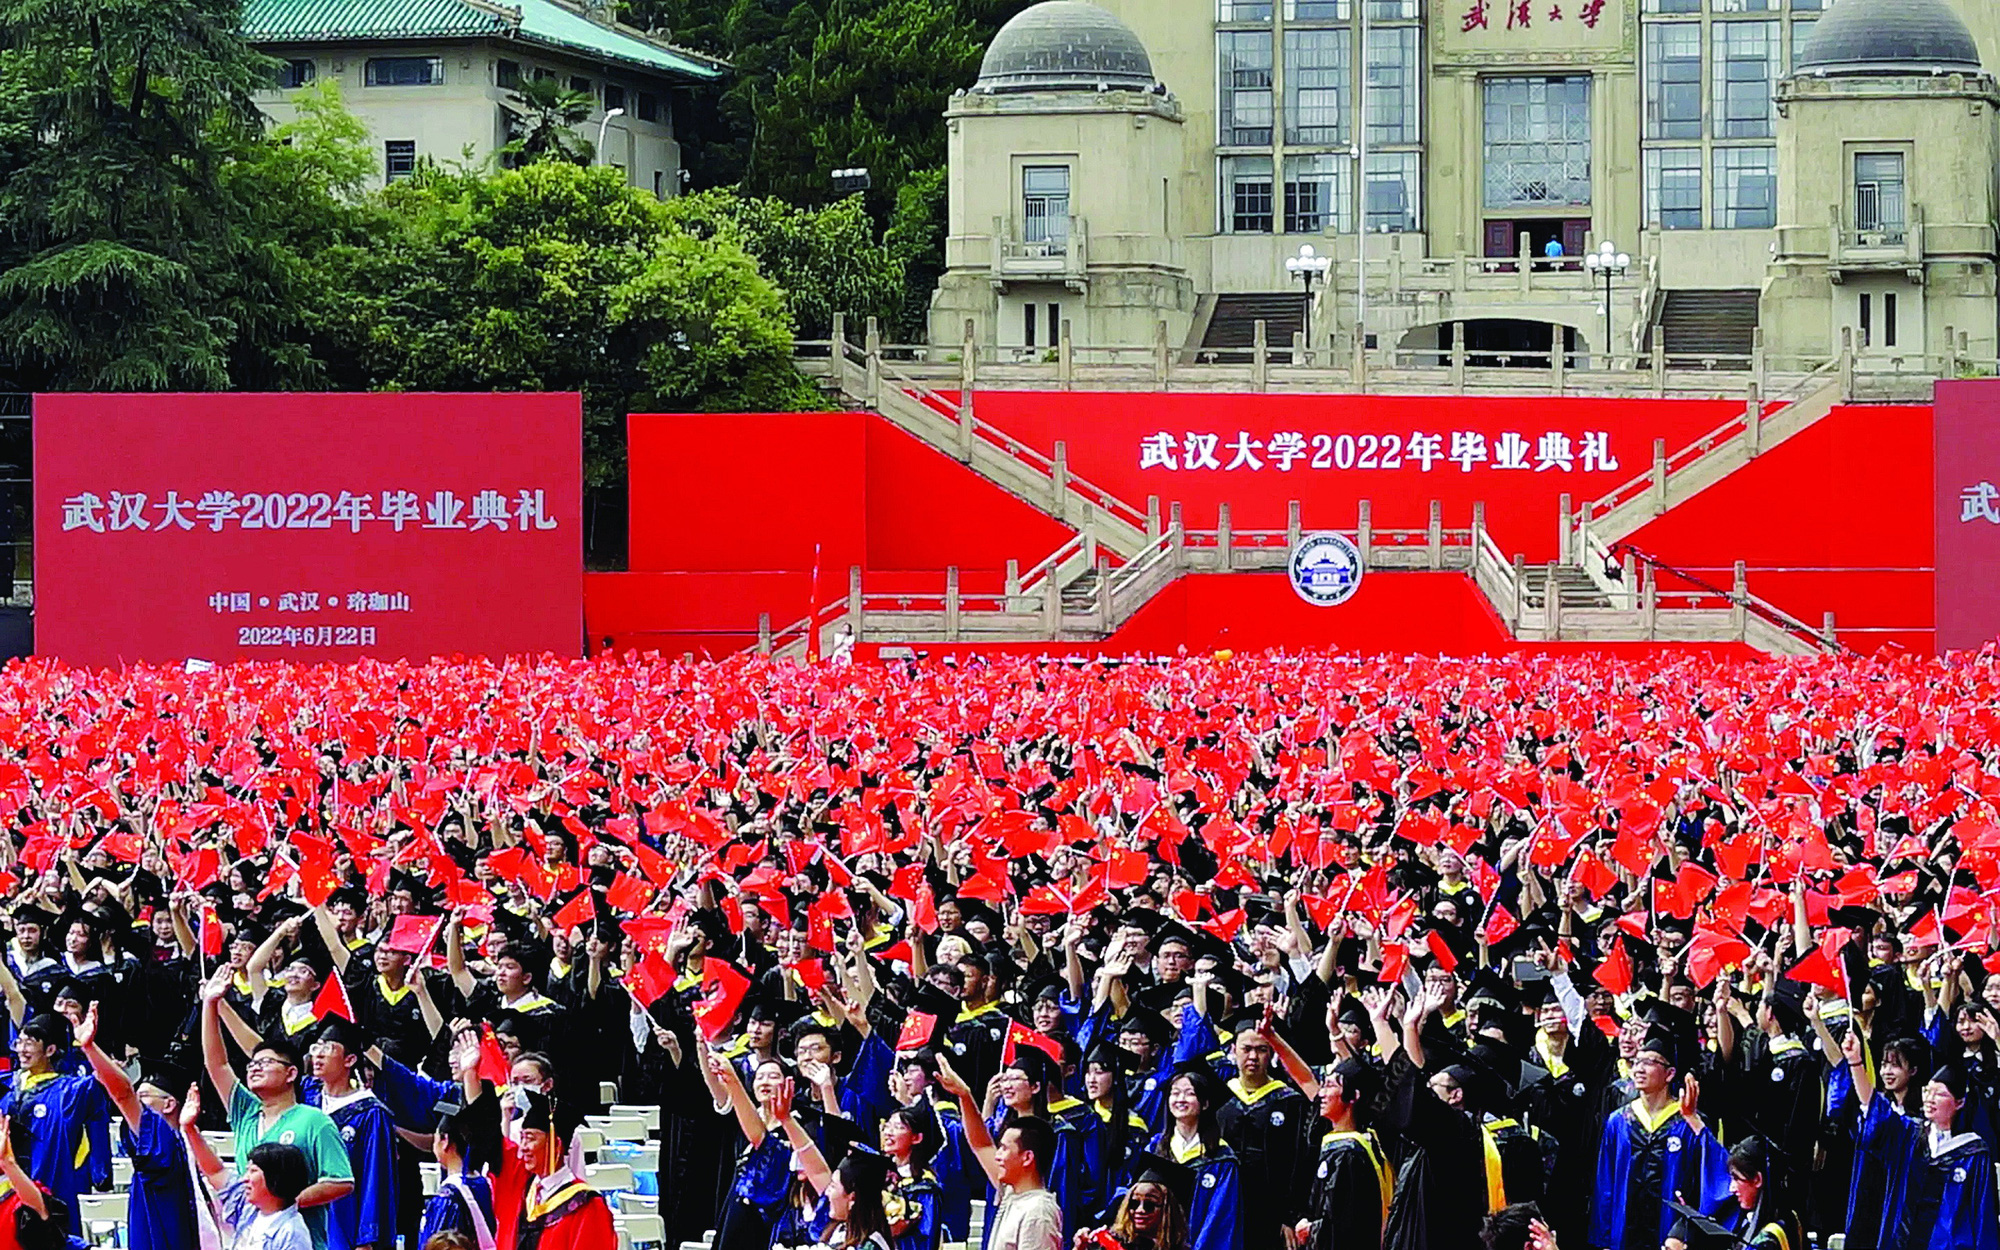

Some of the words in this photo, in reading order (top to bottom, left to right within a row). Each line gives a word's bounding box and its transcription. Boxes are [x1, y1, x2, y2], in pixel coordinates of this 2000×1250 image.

[1140, 431, 1619, 472] 武汉大学2022年毕业典礼
[61, 489, 558, 532] 武汉大学2022年毕业典礼
[238, 626, 377, 647] 2022年6月22日
